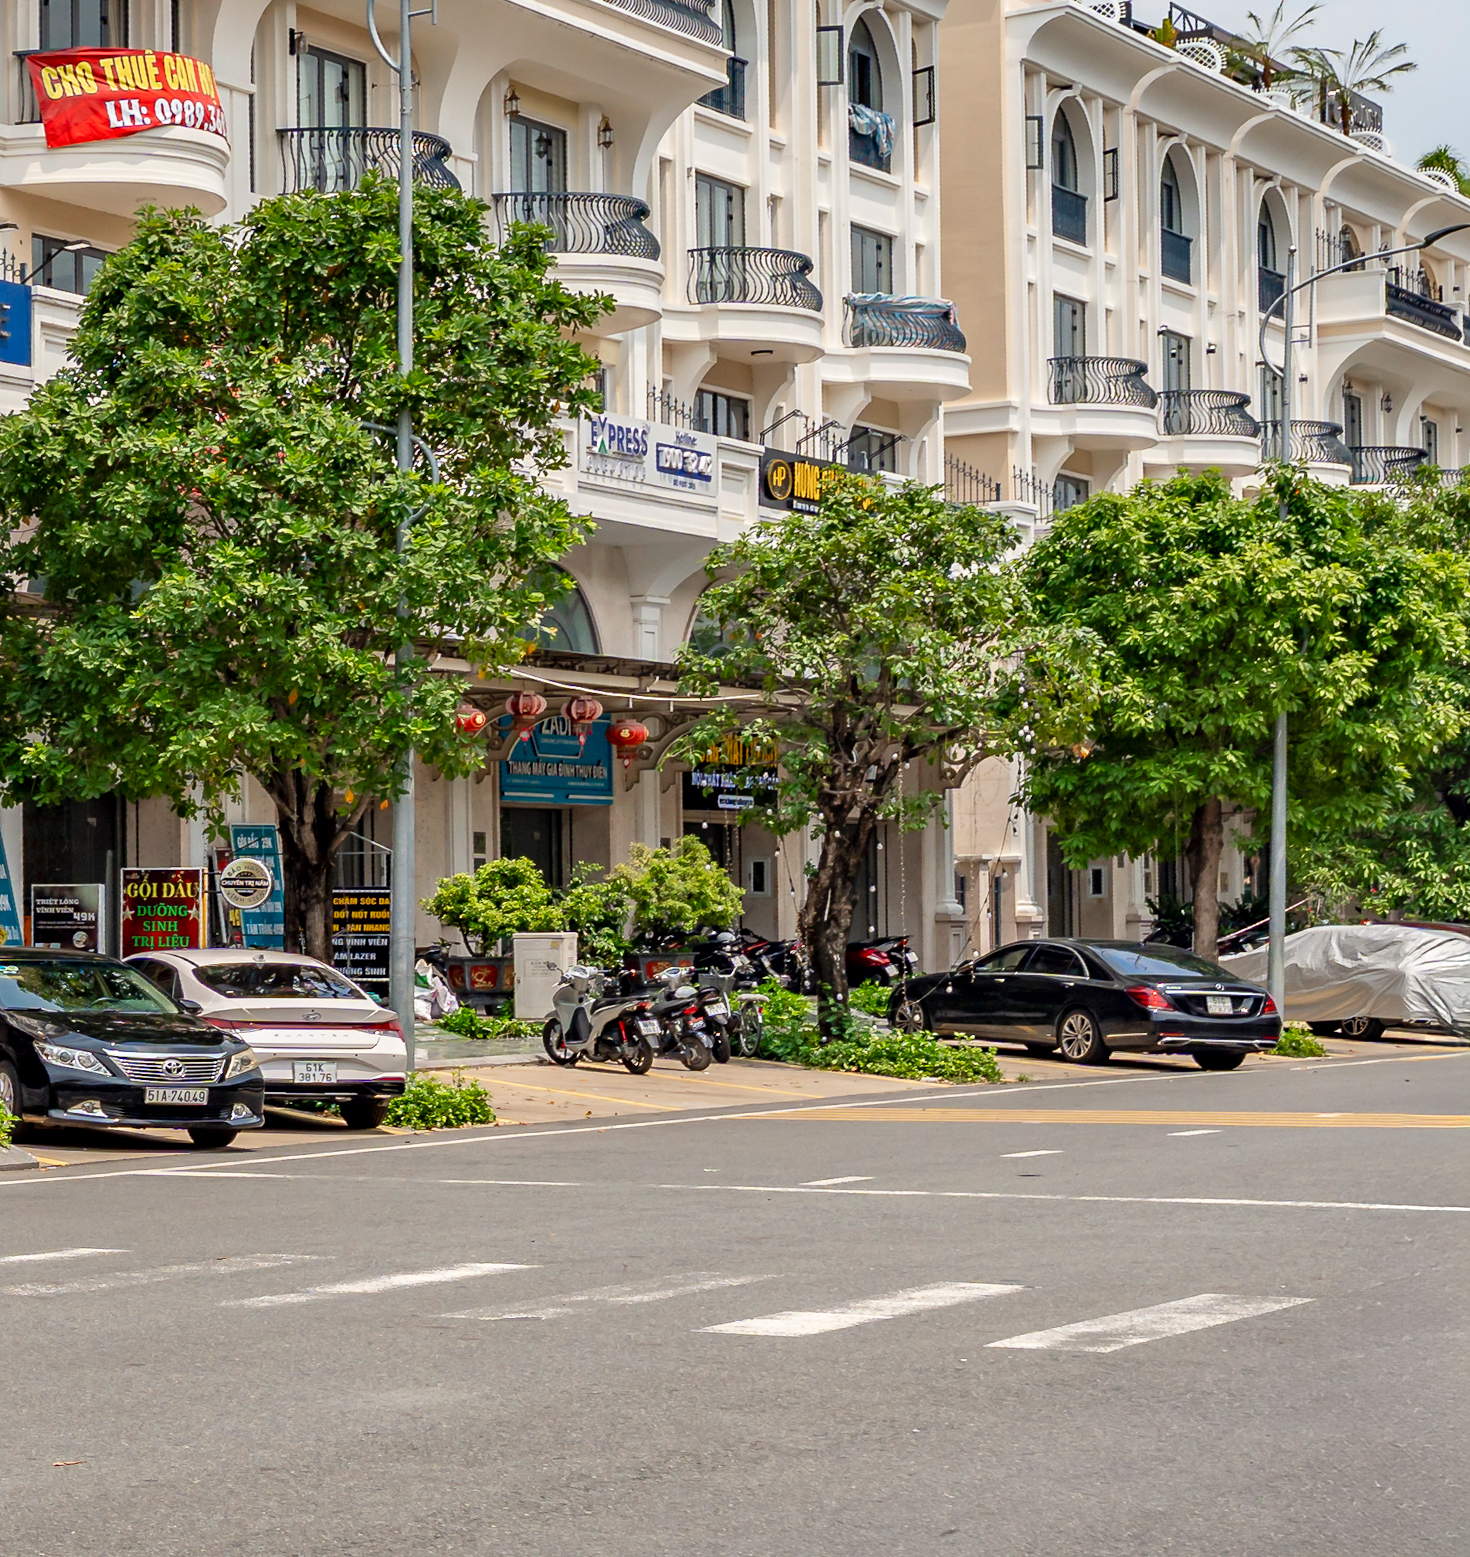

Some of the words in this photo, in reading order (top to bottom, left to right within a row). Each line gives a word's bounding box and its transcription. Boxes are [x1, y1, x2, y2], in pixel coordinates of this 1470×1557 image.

[41, 61, 99, 100] CHO
[99, 49, 163, 91] THUÊ
[105, 98, 151, 128] LH:
[591, 415, 648, 456] EXPRESS
[509, 761, 531, 775] THANG
[547, 763, 557, 776] GIA
[73, 912, 96, 921] 49K
[137, 903, 188, 917] DƯỠNG
[143, 920, 178, 932] SINH
[132, 935, 155, 950] TRỊ
[158, 934, 190, 950] LIỆU
[306, 1063, 324, 1072] 61K
[298, 1072, 332, 1082] 381.76
[148, 1089, 205, 1103] 51A-740.49
